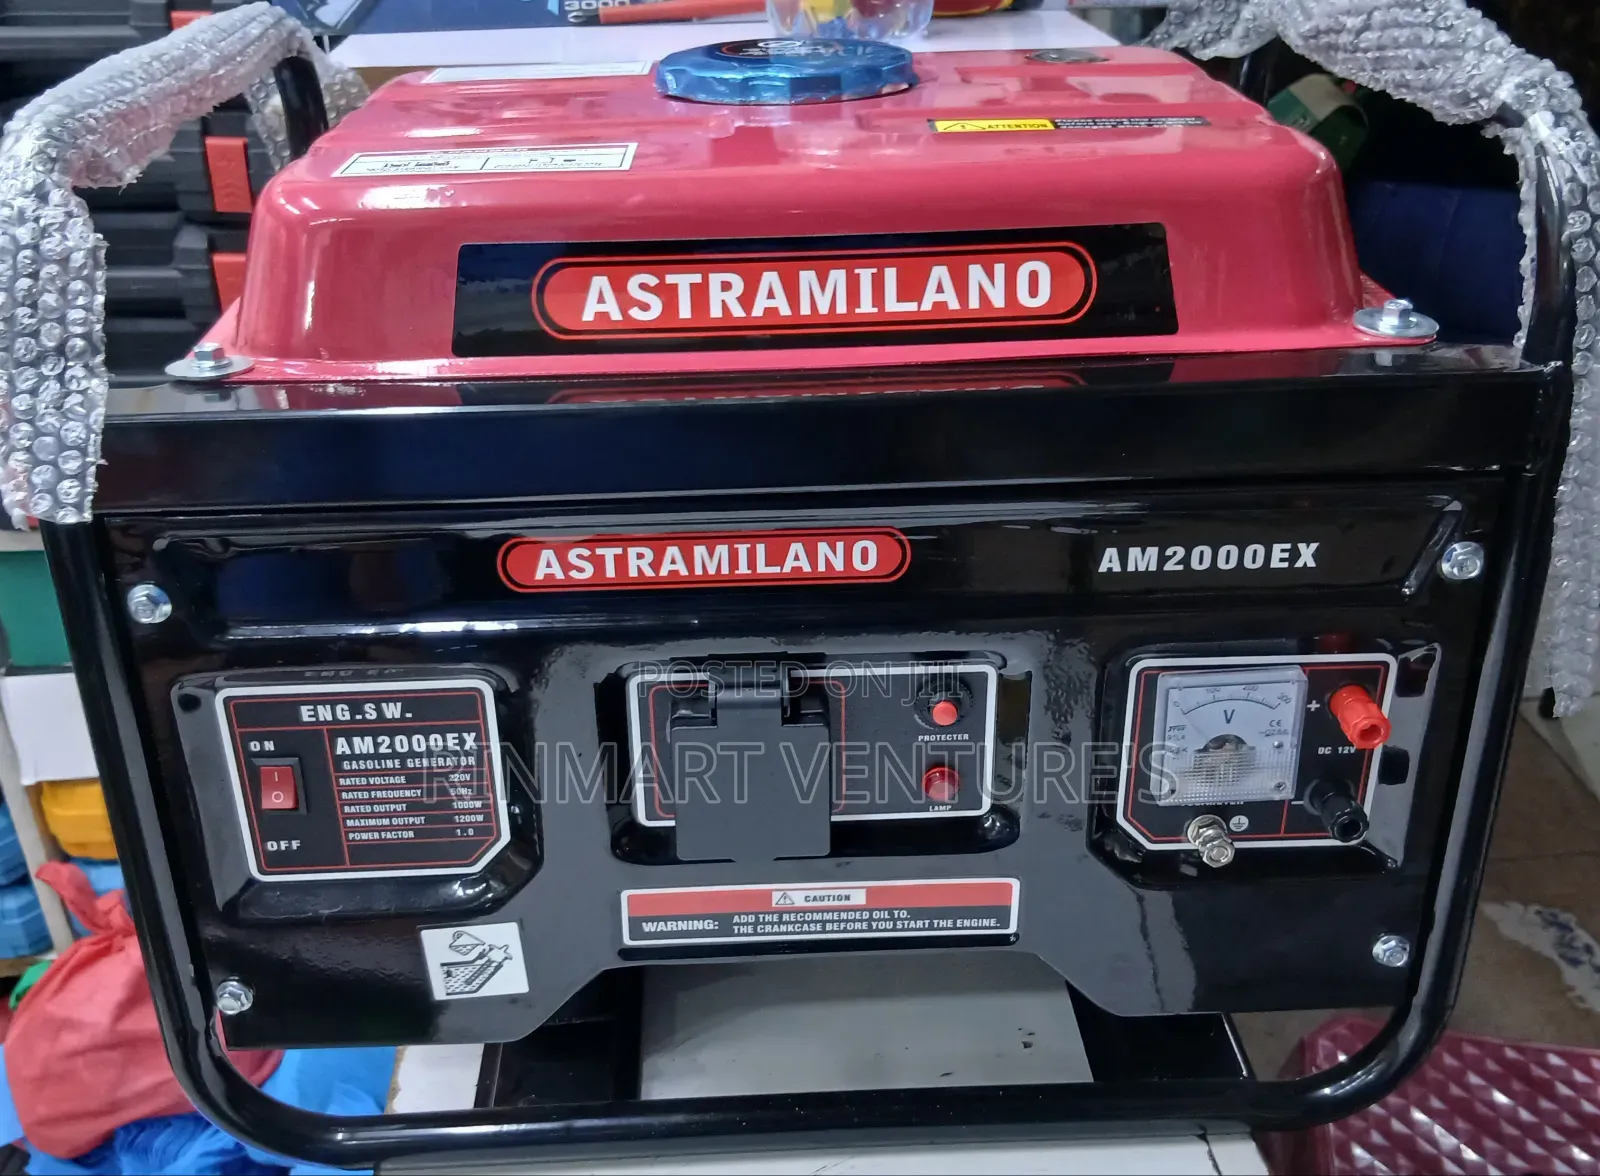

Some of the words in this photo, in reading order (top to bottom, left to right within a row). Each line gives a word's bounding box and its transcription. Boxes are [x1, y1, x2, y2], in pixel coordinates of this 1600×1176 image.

[581, 260, 1051, 322] ASTRAMILANO
[534, 539, 878, 580] ASTRAMILANO
[1098, 542, 1320, 573] AM2000EX
[1223, 709, 1236, 725] V
[336, 732, 478, 755] AM2000EX
[918, 733, 969, 742] PROTECTER
[250, 740, 275, 752] ON
[1317, 746, 1332, 755] DC
[1337, 745, 1356, 754] 12V
[343, 759, 402, 770] GASOLINE
[406, 756, 476, 768] GENERATOR
[339, 777, 367, 786] RATED
[368, 775, 407, 785] VOLTAGE
[448, 773, 471, 782] 220V
[341, 791, 369, 800] RATED
[370, 789, 422, 799] FREQUENCY
[450, 787, 473, 796] 50Hz
[344, 804, 372, 813] RATED
[373, 803, 407, 812] OUTPUT
[452, 800, 482, 809] 1000W
[929, 804, 952, 812] LAMP
[346, 817, 390, 827] MAXIMUM
[391, 816, 426, 826] OUTPUT
[454, 814, 484, 823] 1200W
[348, 831, 380, 841] POWER
[381, 830, 415, 839] FACTOR
[456, 828, 474, 837] 1.0
[267, 839, 301, 852] OFF
[804, 893, 851, 903] CAUTION
[732, 914, 756, 924] ADD
[757, 913, 779, 923] THE
[782, 910, 870, 922] RECOMMENDED
[872, 910, 891, 920] OIL
[893, 909, 911, 919] TO.
[642, 919, 719, 932] WARNING:
[732, 925, 754, 934] THE
[756, 923, 823, 933] CRANKCASE
[826, 921, 869, 931] BEFORE
[871, 920, 893, 930] YOU
[896, 919, 931, 929] START
[932, 919, 953, 928] THE
[956, 918, 1001, 928] ENGINE.
